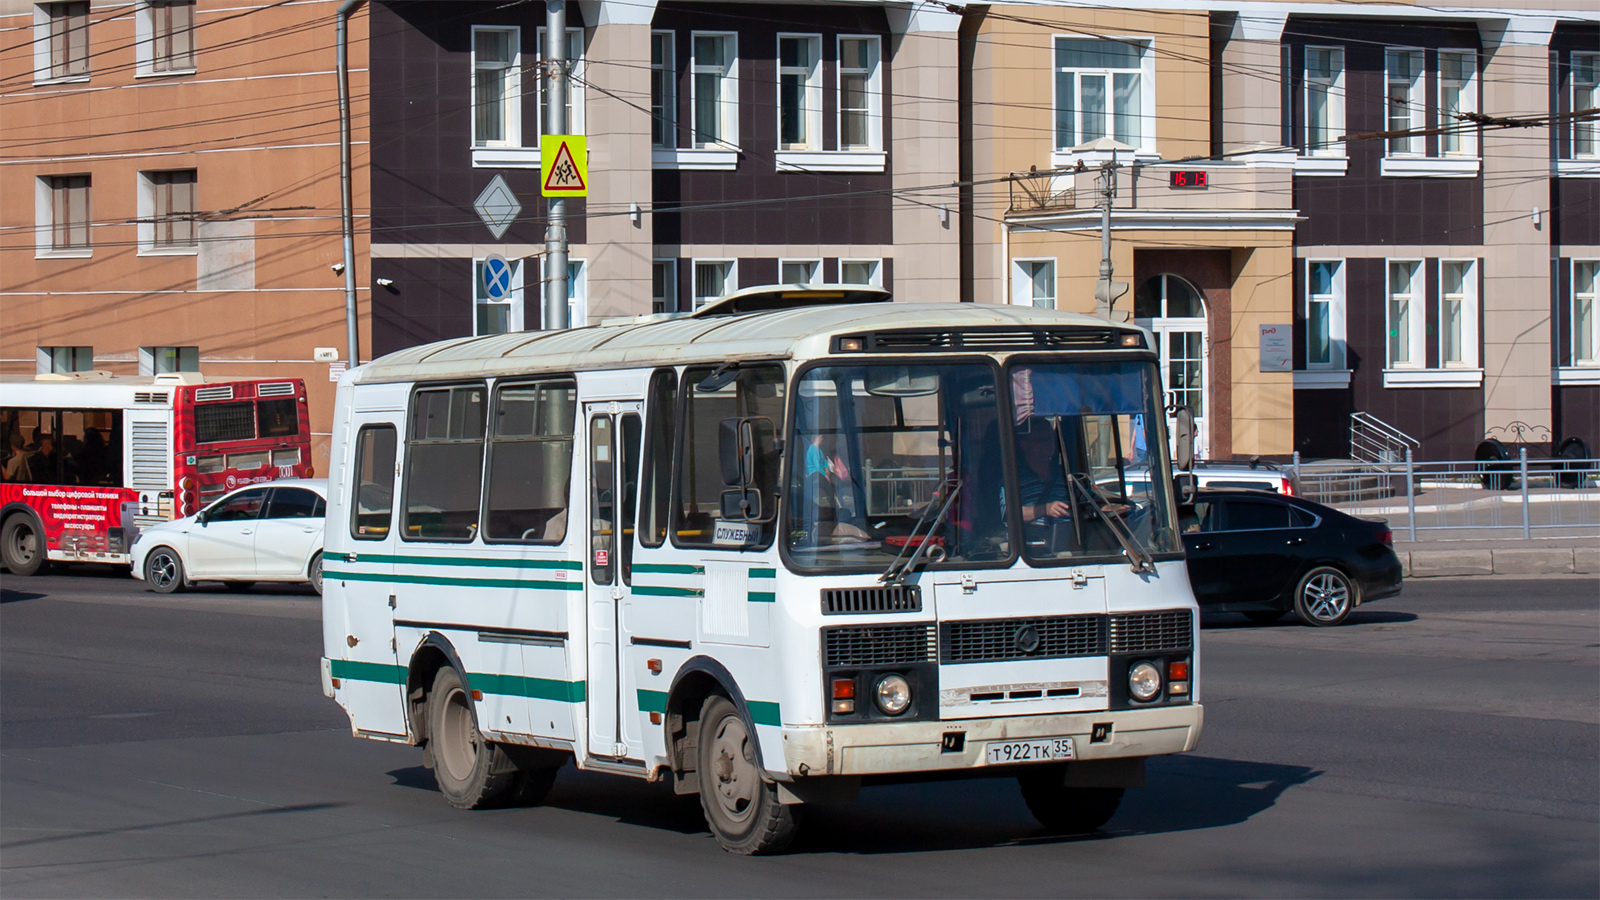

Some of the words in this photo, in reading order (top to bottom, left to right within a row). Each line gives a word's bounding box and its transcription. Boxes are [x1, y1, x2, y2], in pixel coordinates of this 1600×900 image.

[1175, 171, 1187, 186] 16
[1194, 171, 1206, 186] 13
[22, 488, 48, 497] большой
[48, 489, 66, 498] выбор
[66, 490, 95, 499] цифровой
[51, 503, 77, 511] телефоны
[53, 513, 105, 521] видеорегистраторы
[716, 527, 759, 543] СЛУЖЕБНЫЙ
[1054, 740, 1069, 753] 35
